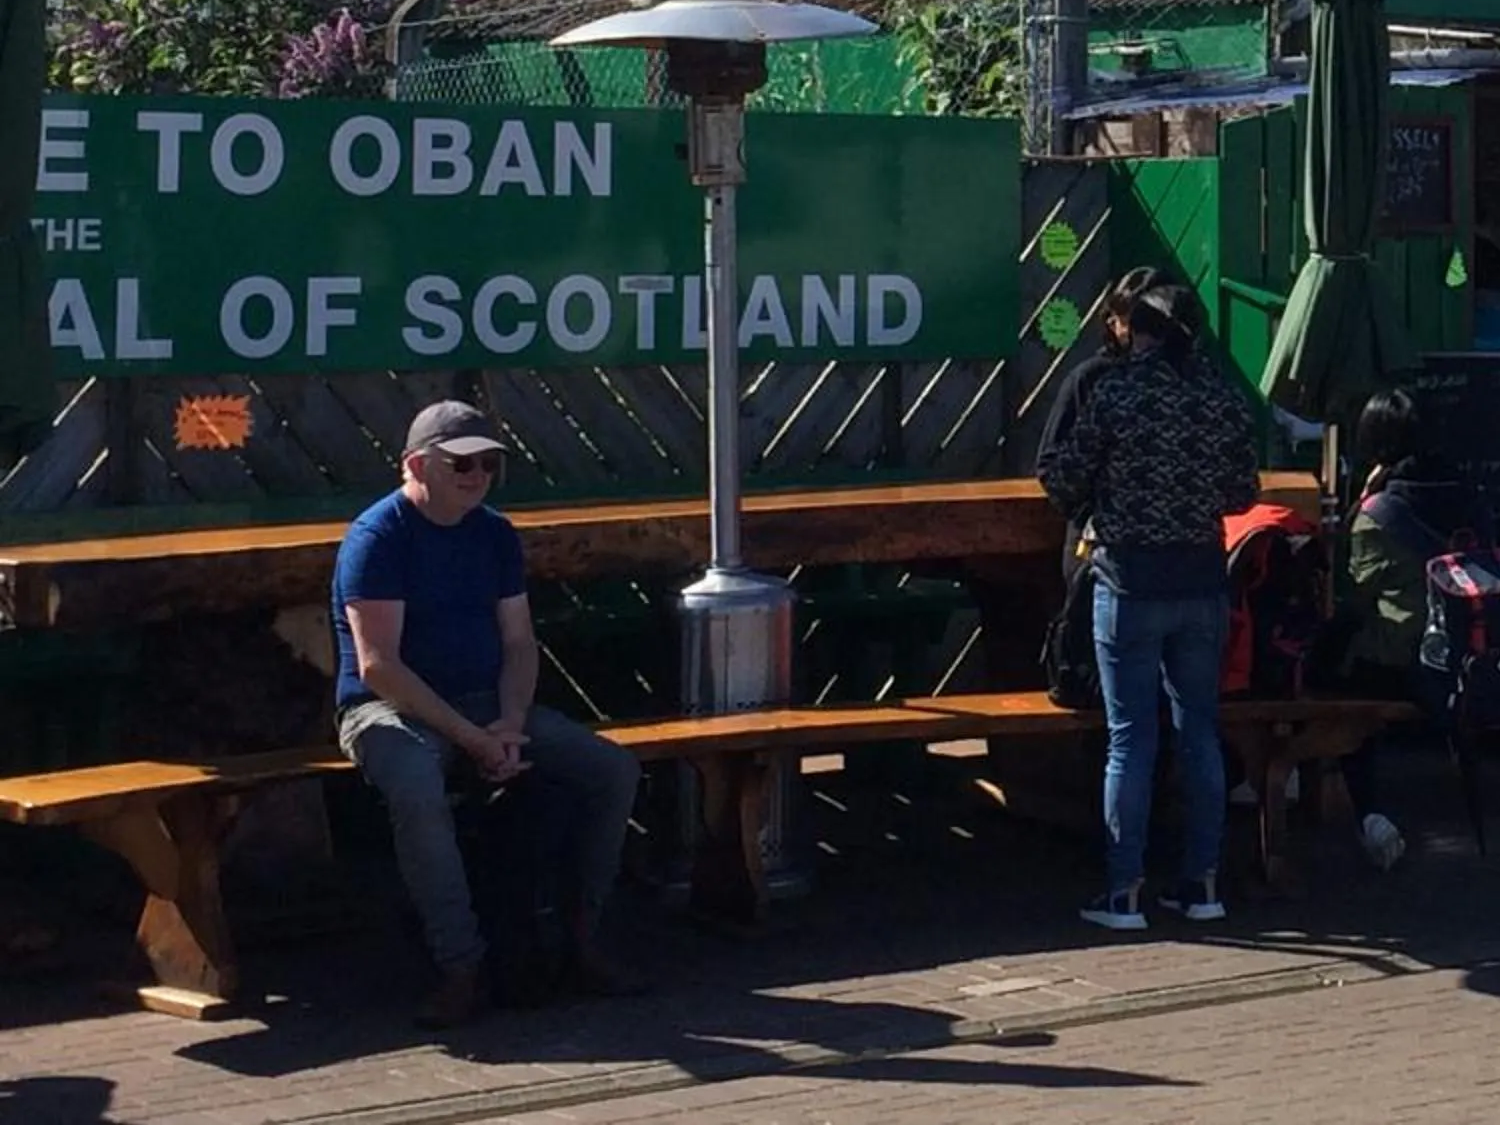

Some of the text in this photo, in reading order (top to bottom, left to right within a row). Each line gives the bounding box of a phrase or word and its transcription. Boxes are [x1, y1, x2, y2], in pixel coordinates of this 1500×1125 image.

[137, 111, 285, 195] TO
[329, 114, 612, 196] OBAN
[219, 275, 361, 358] OF
[401, 273, 923, 356] SCOTLAND
